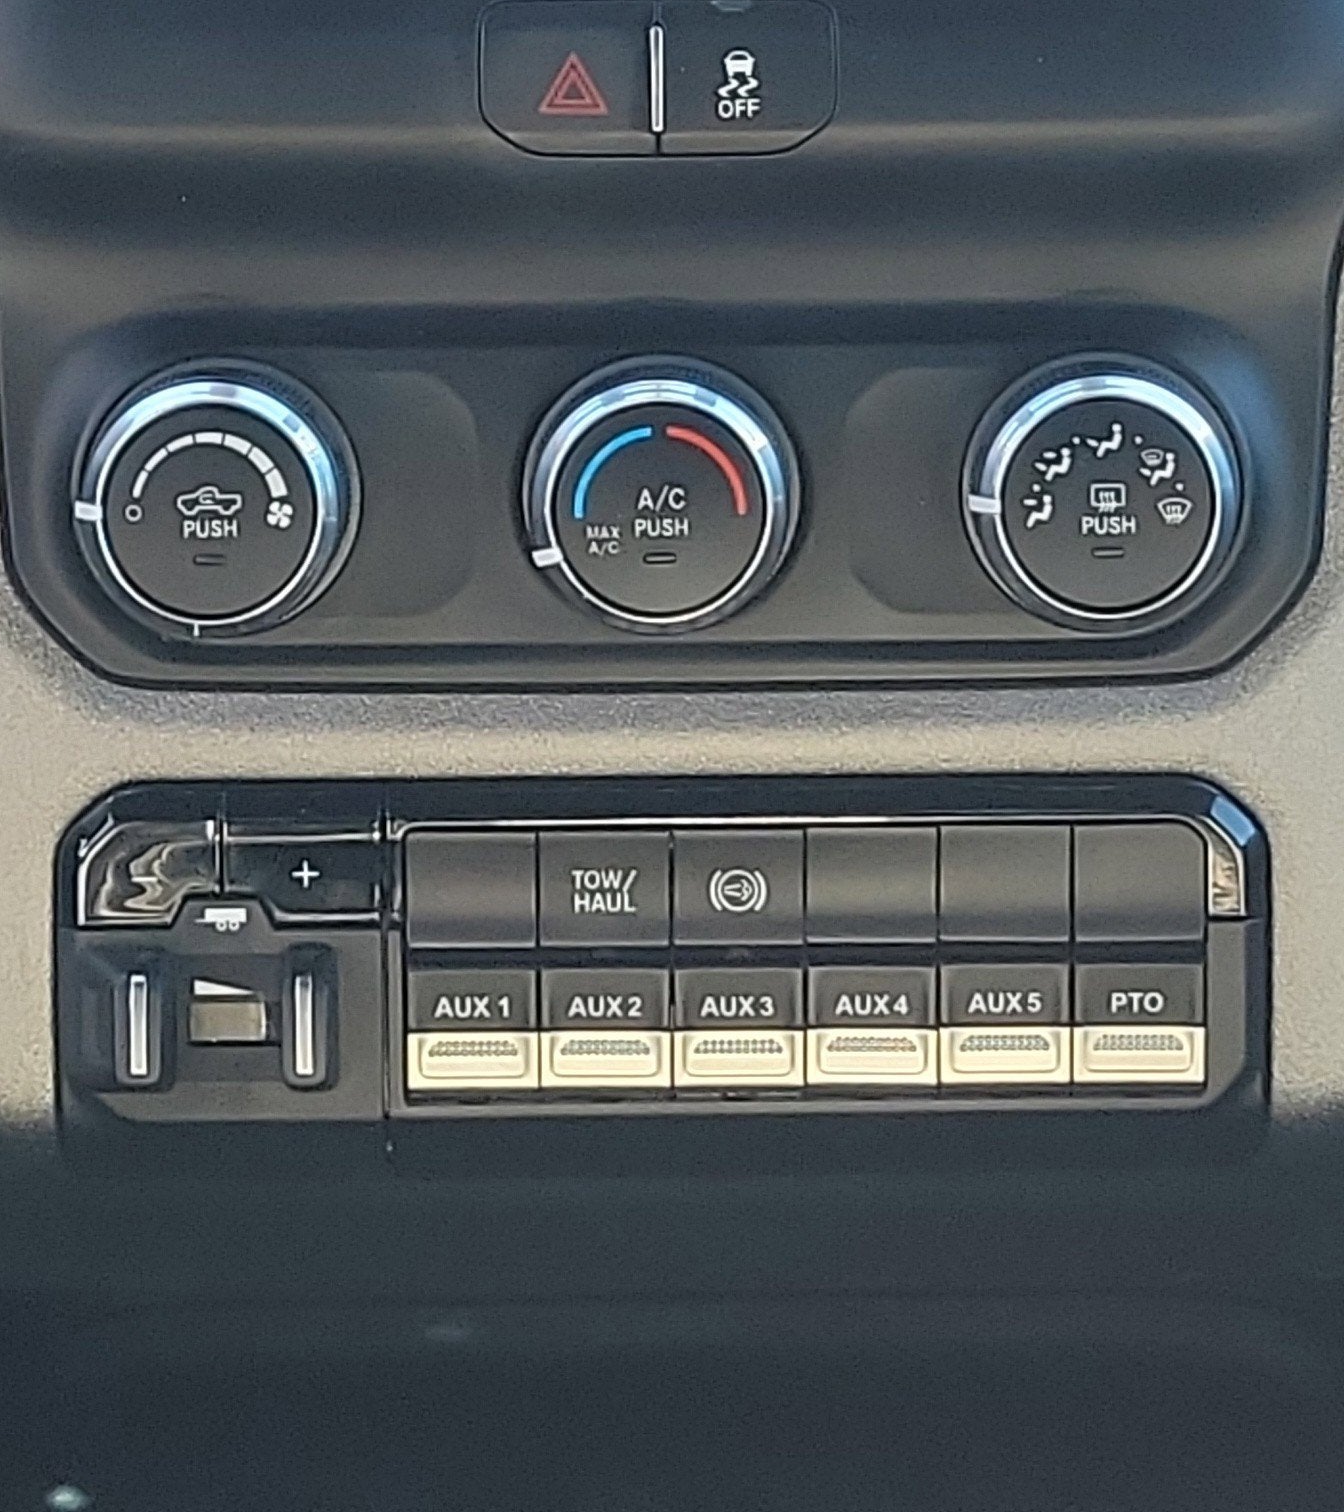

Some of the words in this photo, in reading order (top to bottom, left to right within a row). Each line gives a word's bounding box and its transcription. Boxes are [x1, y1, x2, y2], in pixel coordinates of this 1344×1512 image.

[717, 99, 761, 120] OFF
[636, 485, 687, 512] A/C
[183, 519, 238, 539] PUSH
[586, 525, 621, 539] MAX
[634, 518, 689, 538] PUSH
[1081, 515, 1137, 535] PUSH
[588, 541, 620, 555] A/C
[571, 868, 637, 894] TOW/
[573, 892, 637, 914] HAUL
[434, 995, 490, 1019] AUX
[498, 995, 511, 1019] 1
[567, 995, 624, 1018] AUX
[627, 995, 643, 1018] 2
[700, 995, 757, 1017] AUX
[759, 995, 775, 1017] 3
[835, 993, 890, 1016] AUX
[892, 993, 909, 1016] 4
[968, 991, 1024, 1014] AUX
[1026, 991, 1043, 1014] 5
[1110, 991, 1165, 1014] PTO
